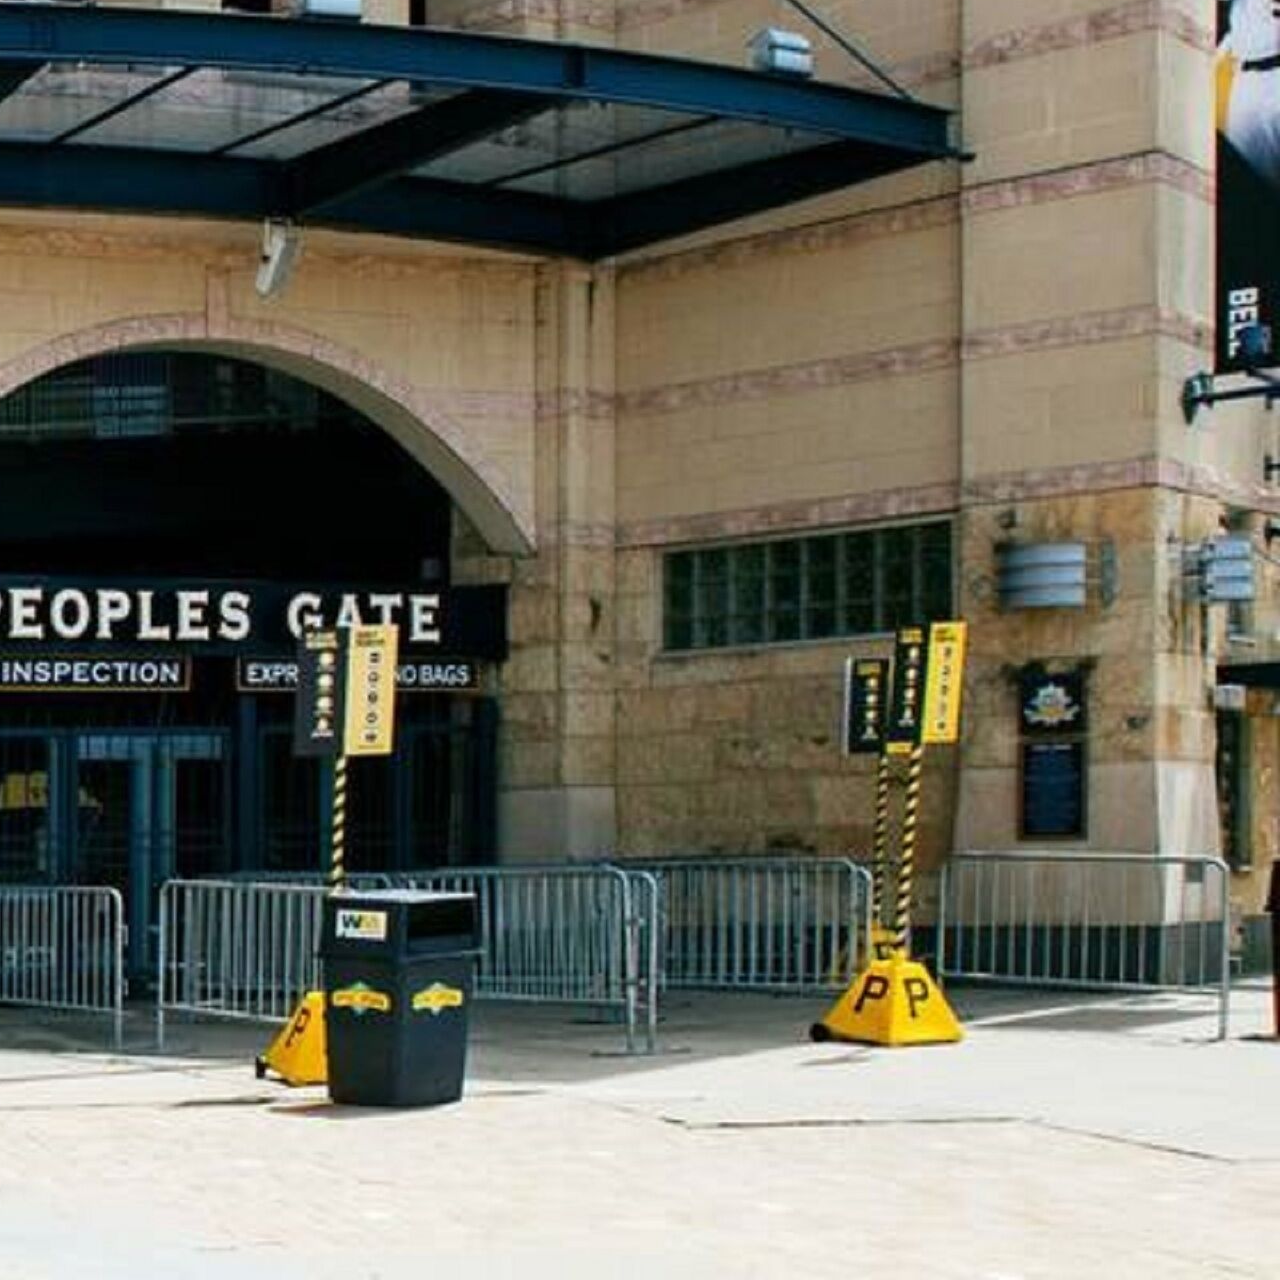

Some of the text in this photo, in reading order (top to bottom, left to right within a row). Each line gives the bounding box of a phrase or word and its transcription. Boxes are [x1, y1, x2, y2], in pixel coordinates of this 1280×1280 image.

[287, 592, 441, 643] GATE
[2, 661, 180, 683] INSPECTION
[420, 664, 469, 685] BAGS
[854, 975, 889, 1013] P
[903, 977, 929, 1018] P
